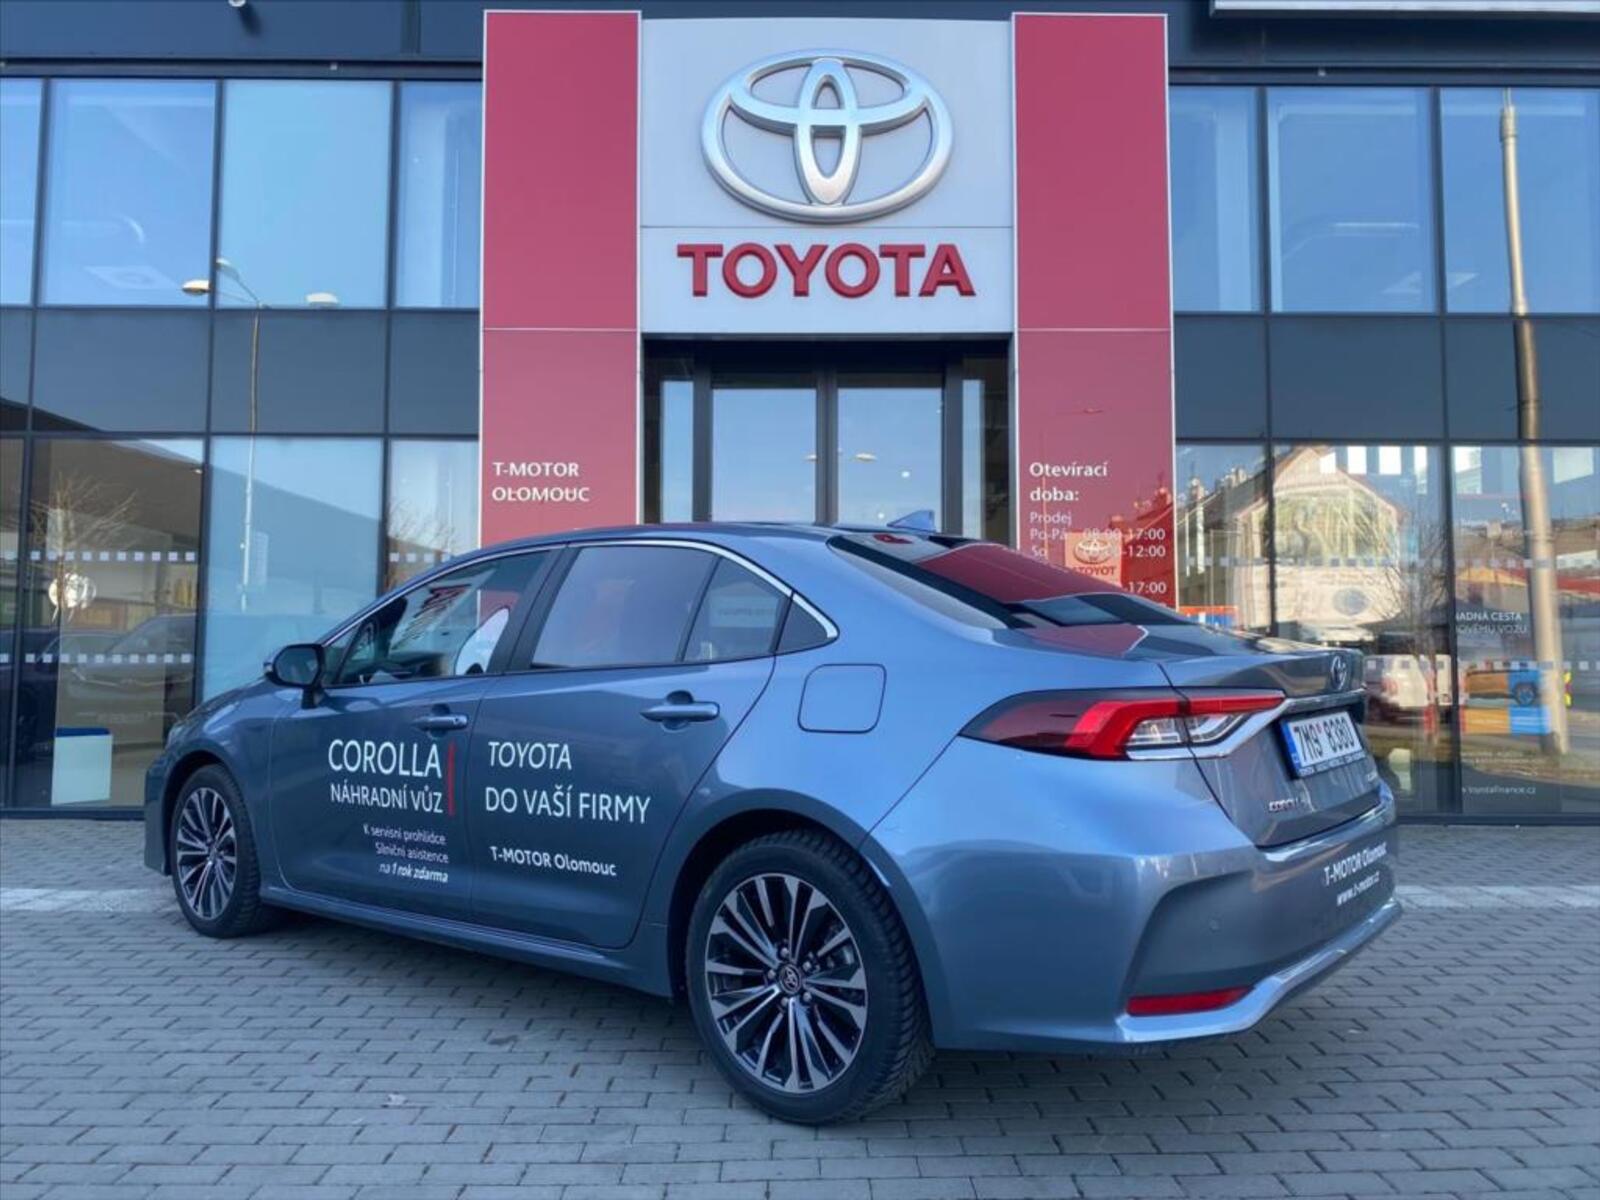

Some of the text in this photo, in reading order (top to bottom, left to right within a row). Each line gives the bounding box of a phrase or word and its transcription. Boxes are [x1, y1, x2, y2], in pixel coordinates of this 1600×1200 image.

[677, 243, 976, 298] TOYOTA
[492, 462, 579, 477] T-MOTOR
[1029, 462, 1109, 477] Otevírací
[492, 487, 590, 502] OLOMOUC
[1030, 488, 1079, 502] doba:
[1030, 512, 1072, 526] Prodej
[1491, 611, 1522, 622] CESTA
[328, 739, 443, 779] COROLLA
[488, 741, 572, 770] TOYOTA
[330, 779, 444, 814] NÁHRADNÍ VŮZ
[486, 784, 651, 824] DO VAŠÍ FIRMY
[362, 824, 370, 834] K
[407, 847, 449, 863] asistence
[490, 846, 617, 877] T-MOTOR Olomouc
[379, 863, 391, 874] na
[397, 863, 413, 878] rok
[413, 866, 449, 883] zdarma
[1324, 853, 1362, 885] T-MOTOR
